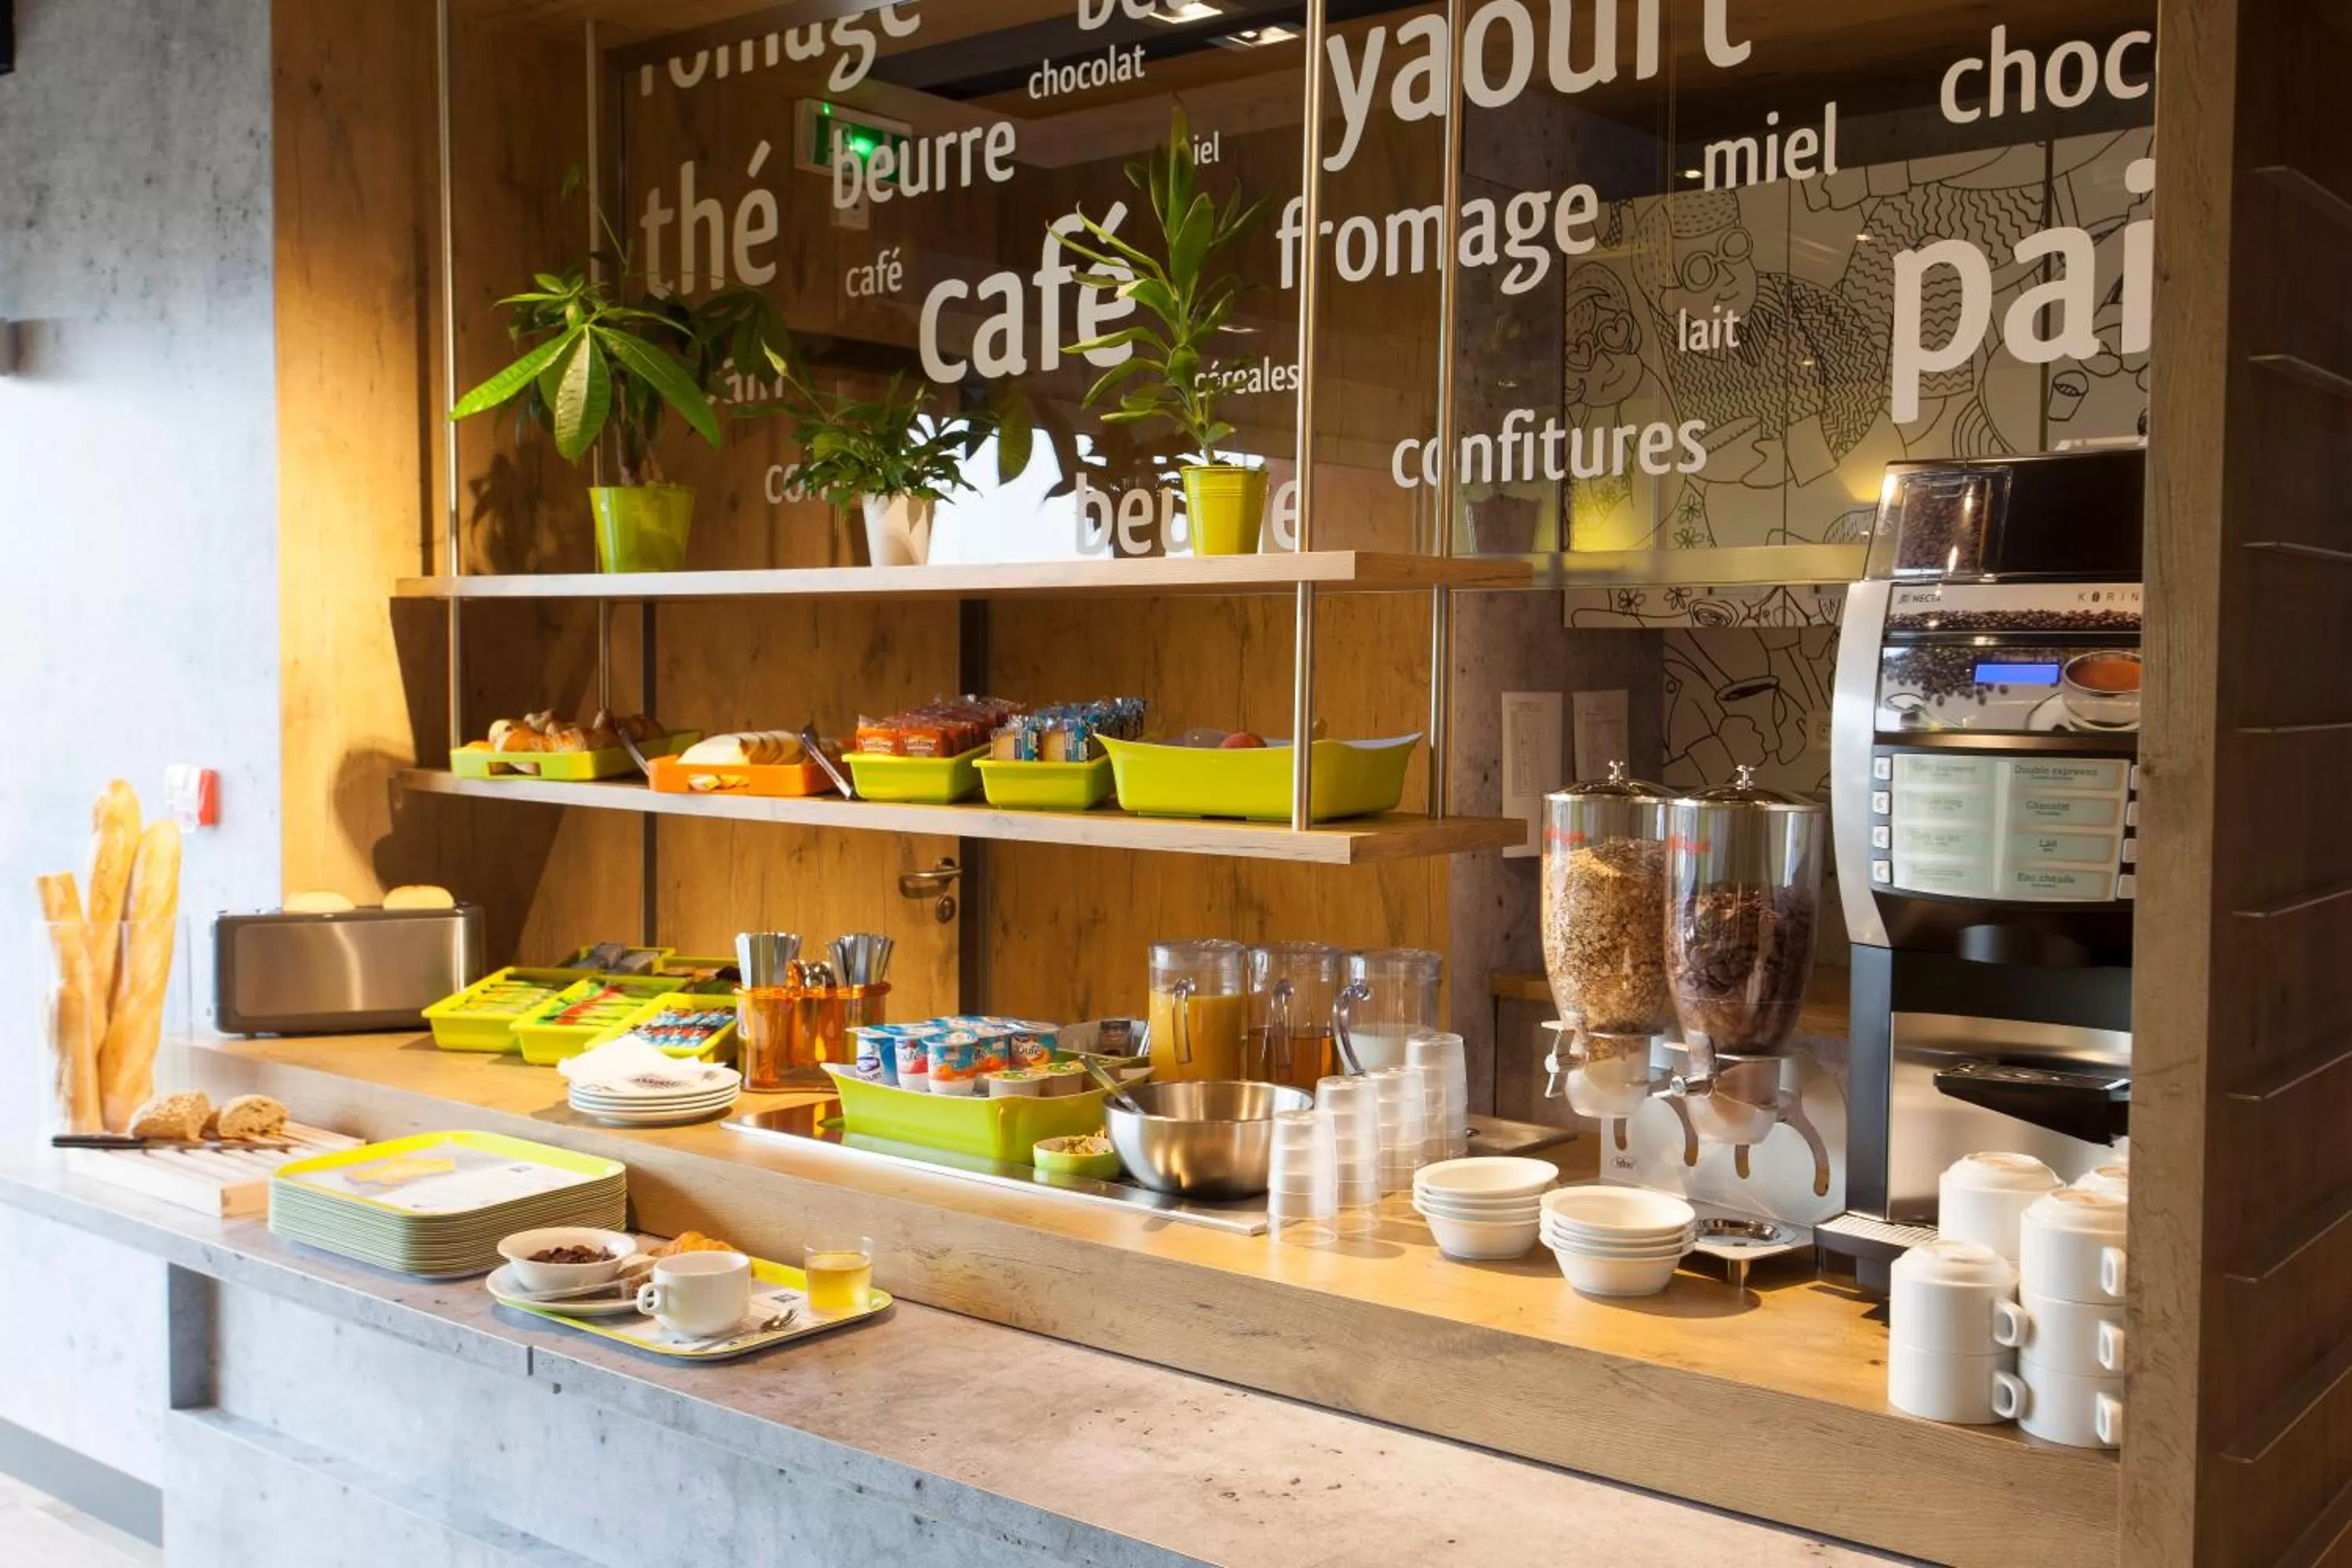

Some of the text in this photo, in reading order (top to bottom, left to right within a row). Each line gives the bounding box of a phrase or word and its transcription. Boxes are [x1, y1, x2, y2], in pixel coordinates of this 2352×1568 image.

[1028, 44, 1145, 99] chocolat
[833, 121, 1016, 209] beurre
[1194, 130, 1220, 165] iel
[1704, 101, 1838, 192] miel
[639, 140, 779, 300] thé
[844, 247, 904, 298] café
[919, 200, 1137, 383] café
[1679, 307, 1740, 352] lait
[1076, 472, 1298, 555] beue
